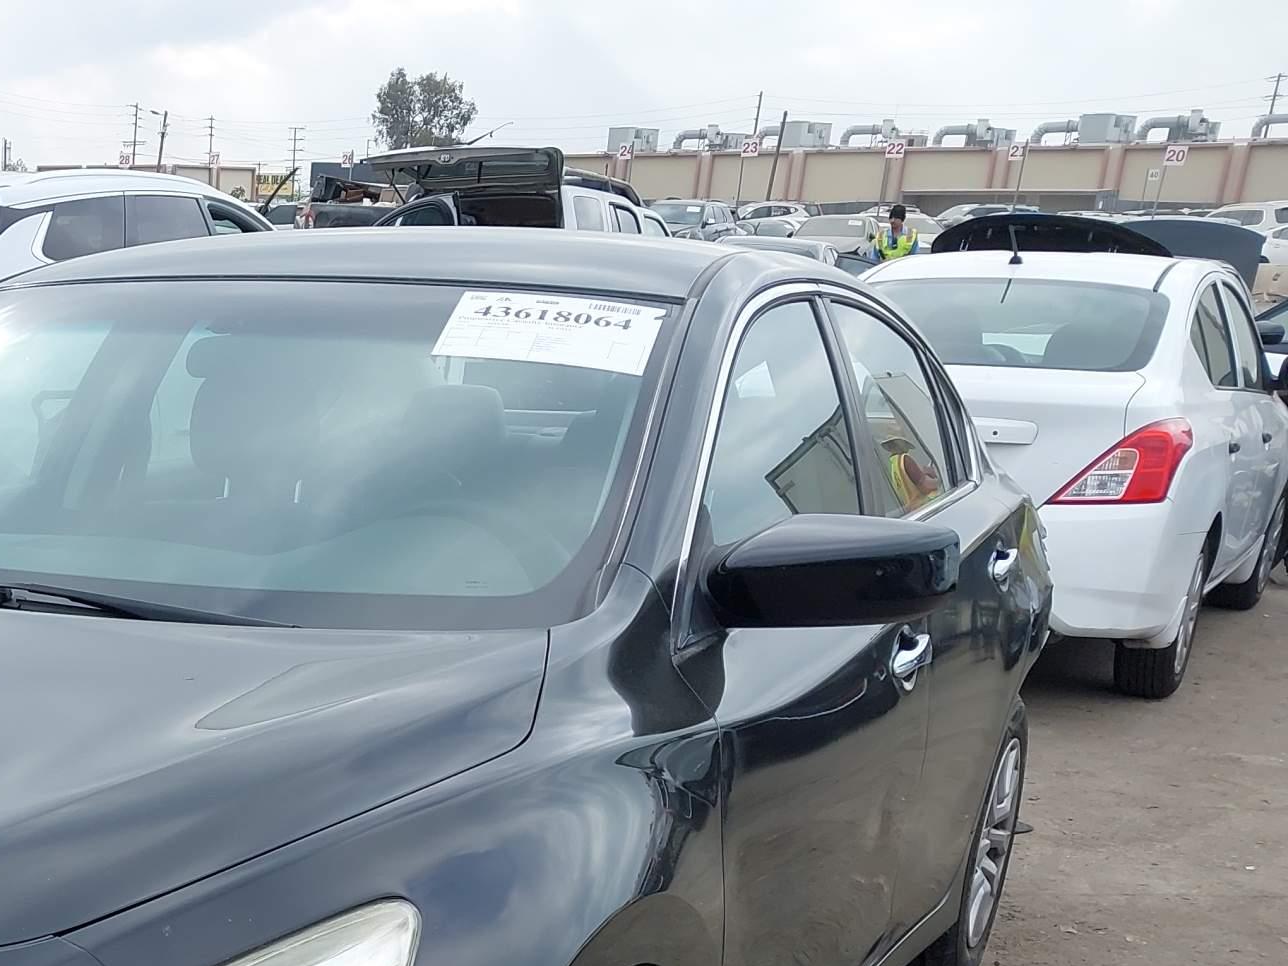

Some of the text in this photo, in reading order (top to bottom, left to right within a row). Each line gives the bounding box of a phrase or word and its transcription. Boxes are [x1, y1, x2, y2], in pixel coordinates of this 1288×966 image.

[742, 142, 758, 153] 23
[886, 143, 903, 154] 22
[119, 155, 130, 165] 28
[210, 154, 219, 164] 27
[1165, 149, 1185, 162] 20
[256, 175, 270, 184] EAL
[473, 304, 633, 331] 43618064
